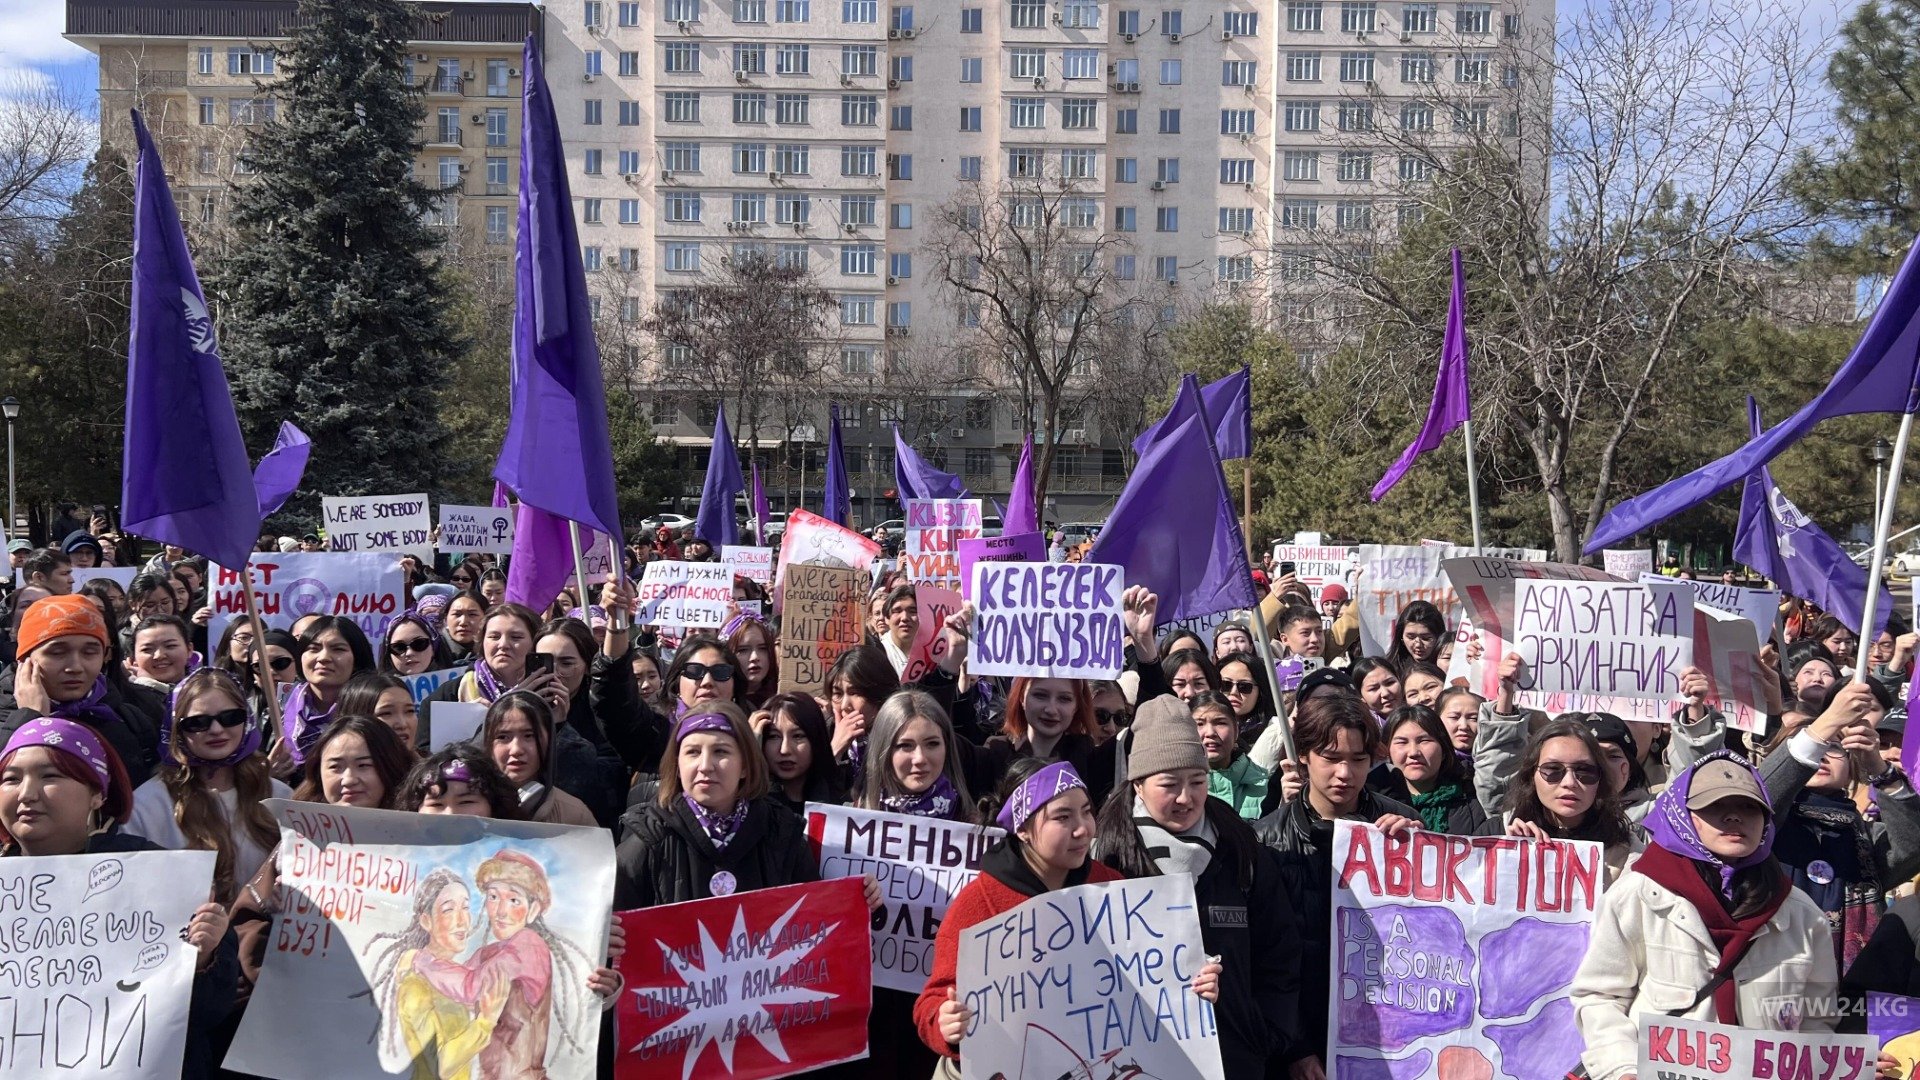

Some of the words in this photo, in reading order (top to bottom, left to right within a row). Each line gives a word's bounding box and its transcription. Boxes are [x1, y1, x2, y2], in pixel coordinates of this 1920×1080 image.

[326, 505, 348, 523] WE
[350, 504, 367, 521] ARE
[372, 501, 423, 519] SOMEBODY
[909, 502, 982, 527] КЫЗГА
[331, 532, 359, 551] NOT
[366, 530, 399, 548] SOME
[402, 529, 427, 545] BODY
[985, 538, 1015, 549] МЕСТО
[1279, 547, 1348, 562] ОБВИНЕНИЕ
[649, 565, 681, 578] НАМ
[686, 567, 728, 580] НУЖНА
[641, 583, 733, 602] БЕЗОПАСНОСТЬ
[639, 606, 648, 620] А
[653, 606, 671, 620] НЕ
[676, 608, 723, 623] ЦВЕТЫ
[802, 601, 819, 614] of
[822, 603, 848, 618] the
[1519, 584, 1678, 638] АЯЛЗАТКА
[791, 617, 860, 643] WITCHES
[1516, 635, 1680, 693] ЭРКИНДИК
[1337, 825, 1600, 912] ABORTION
[277, 918, 332, 958] БУЗ!
[721, 921, 826, 964] АЯЛДАРДА
[1343, 912, 1374, 941] IS
[1388, 913, 1412, 944] A
[1342, 940, 1472, 988] PERSONAL
[636, 974, 728, 1020] ЧЫНДЫК
[1342, 977, 1457, 1015] DECISION
[721, 995, 830, 1044] АЯЛДАРДА
[1648, 1024, 1732, 1074] КЫЗ
